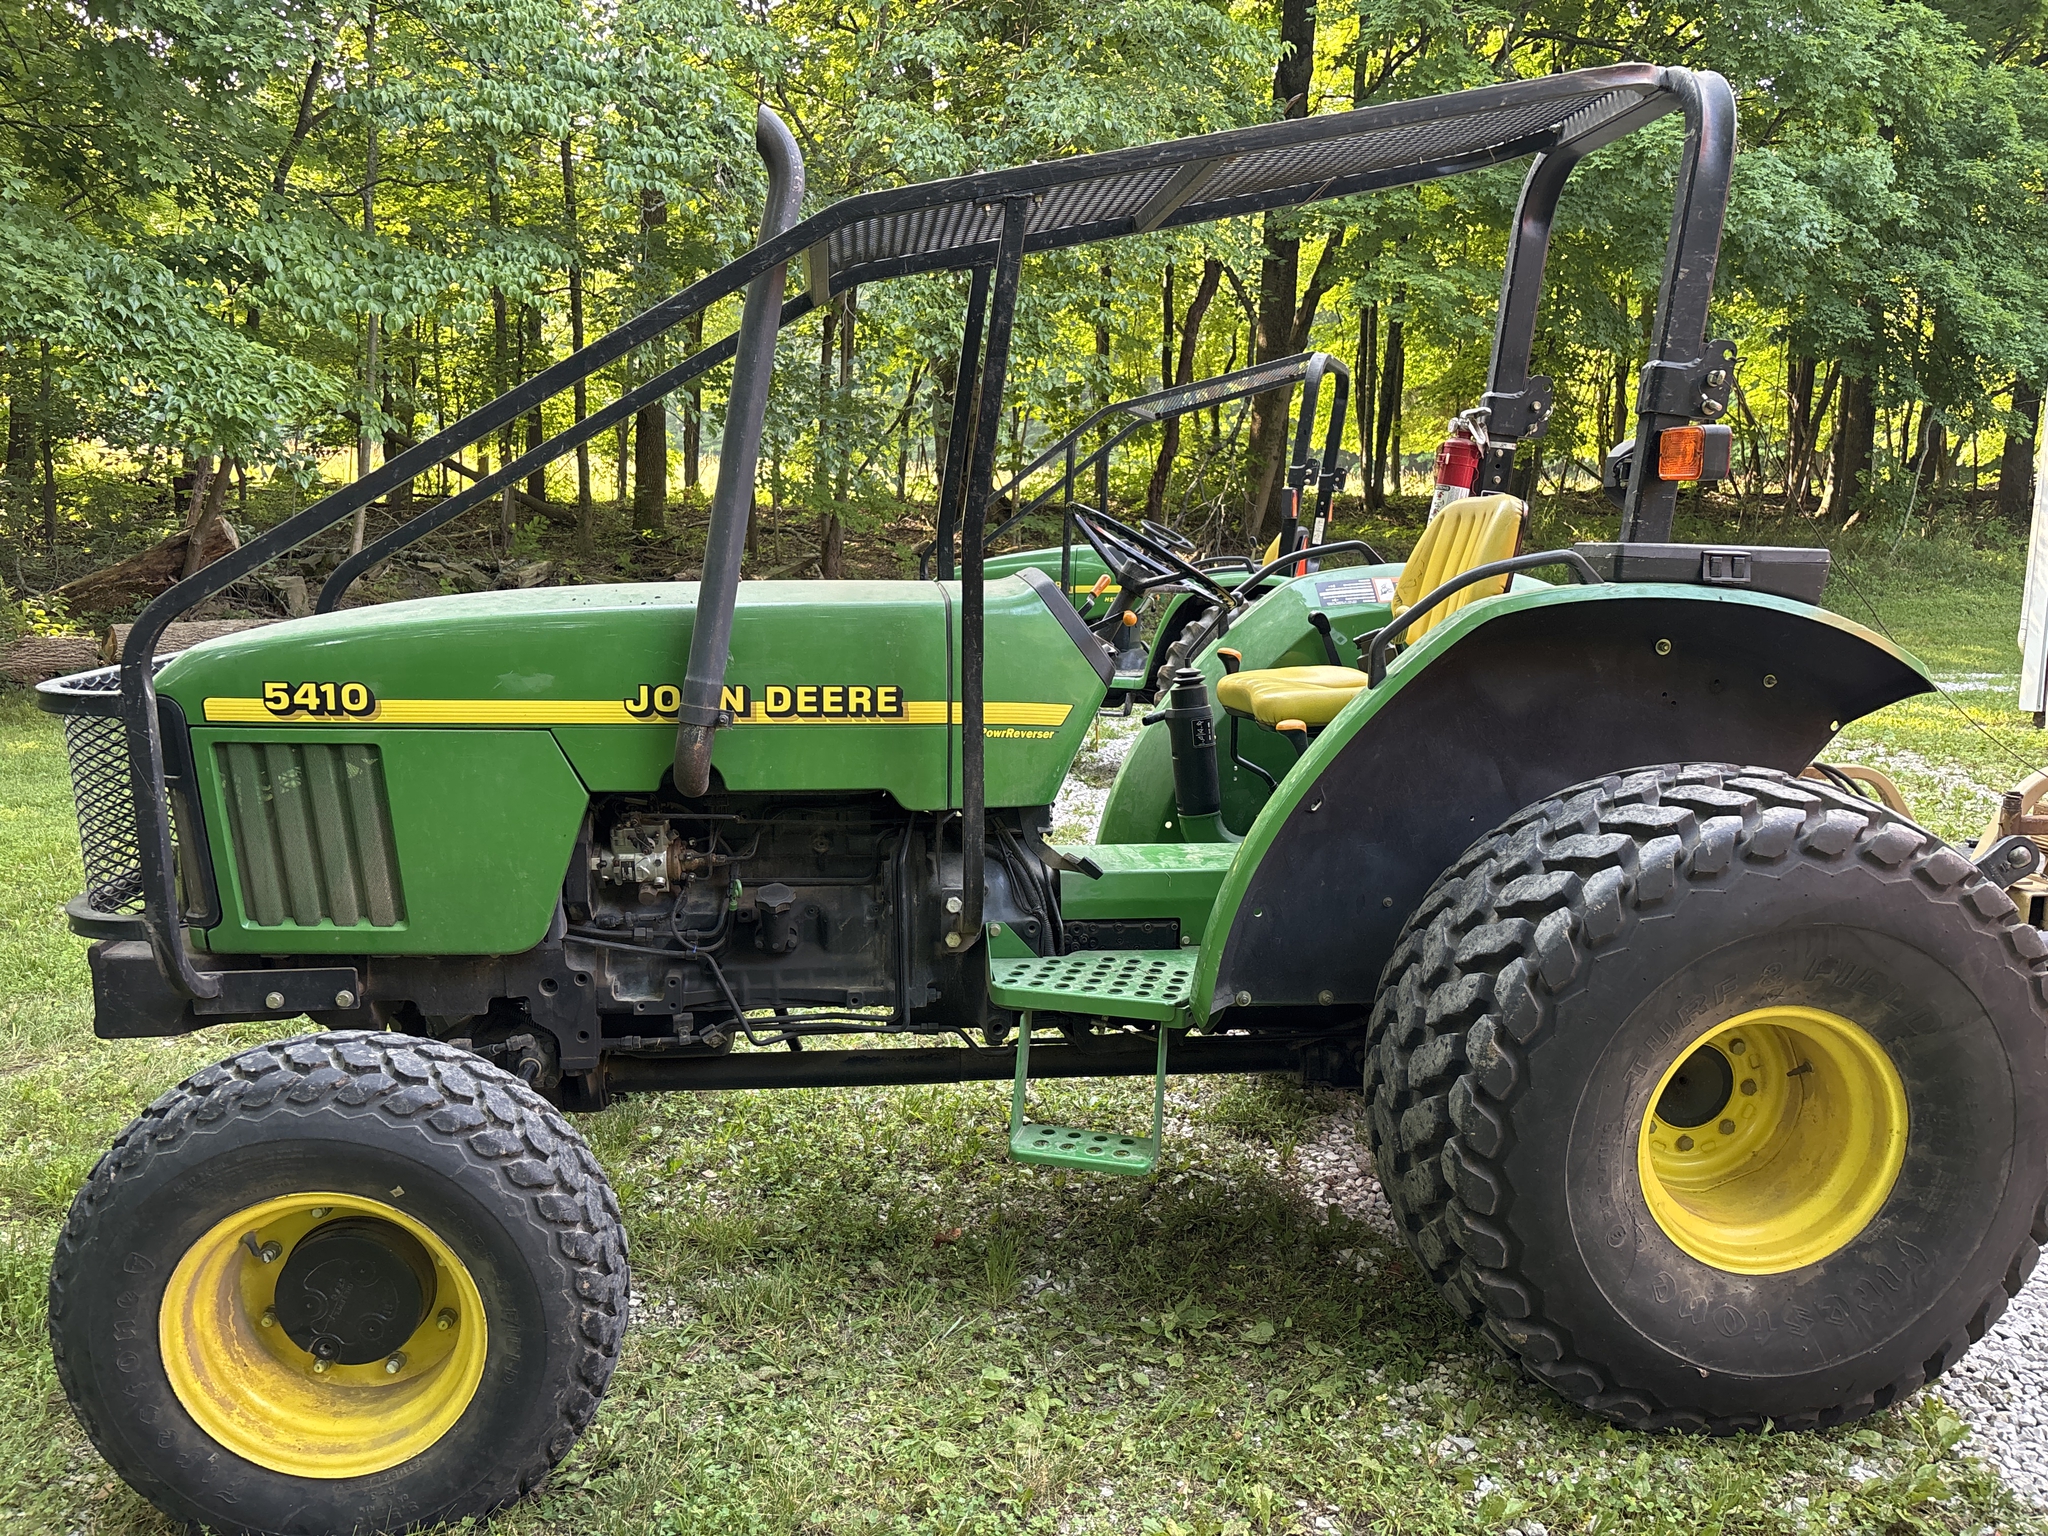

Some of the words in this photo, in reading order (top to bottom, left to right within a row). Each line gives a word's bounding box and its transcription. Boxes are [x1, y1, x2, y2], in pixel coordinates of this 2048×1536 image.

[263, 681, 375, 716] 5410
[624, 684, 751, 718] JON
[765, 685, 904, 718] DEERE
[1622, 973, 1741, 1085] TURF
[1803, 955, 1943, 1036] FIELD
